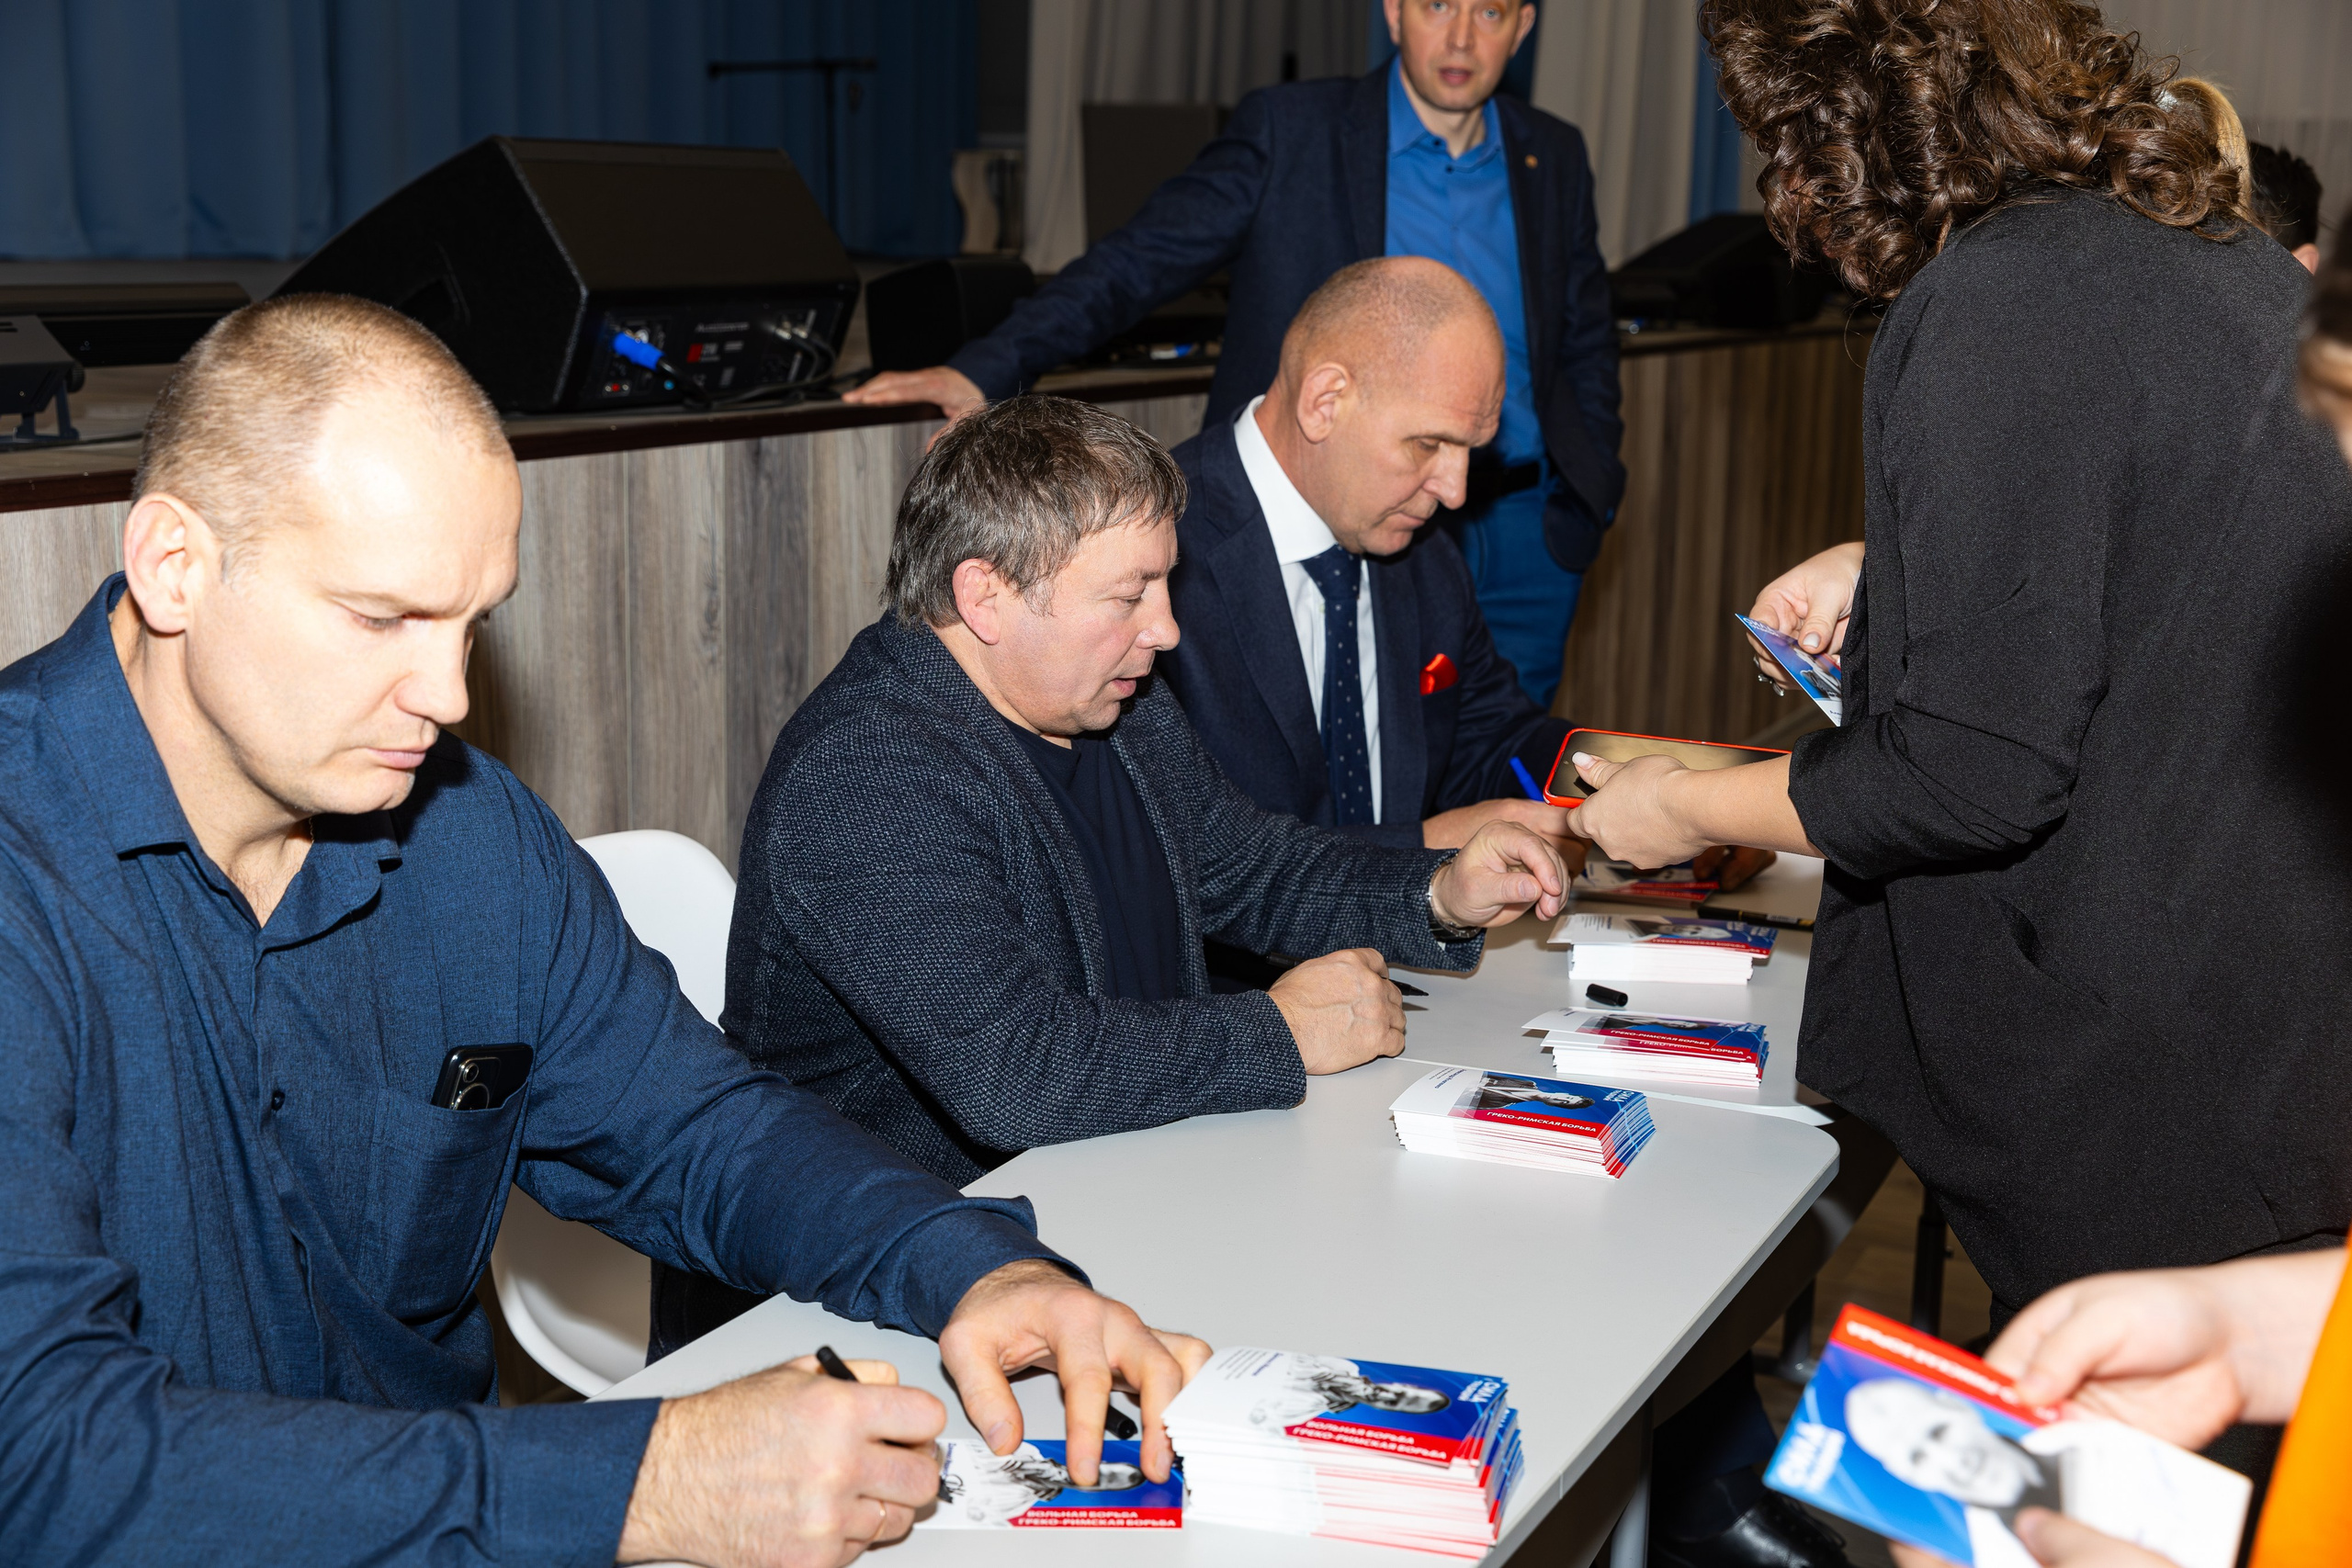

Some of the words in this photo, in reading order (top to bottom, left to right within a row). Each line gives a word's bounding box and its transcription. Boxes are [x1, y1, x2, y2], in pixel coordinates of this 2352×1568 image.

[1610, 1030, 1678, 1042] ГРЕКО-РИМСКАЯ
[1678, 1038, 1710, 1046] БОРЬБА
[1711, 1047, 1744, 1055] БОРЬБА
[1487, 1111, 1561, 1127] ГРЕКО-РИМСКАЯ
[1561, 1122, 1597, 1133] БОРЬБА
[1305, 1420, 1364, 1437] ВОЛЬНАЯ
[1365, 1429, 1415, 1445] БОРЬБА
[1293, 1427, 1396, 1451] ГРЕКО-РИМСКАЯ
[1396, 1444, 1447, 1460] БОРЬБА
[1026, 1509, 1088, 1518] ВОЛЬНАЯ
[1089, 1510, 1138, 1518] БОРЬБА
[1018, 1517, 1125, 1527] ГРЕКО-РИМСКАЯ
[1125, 1518, 1176, 1527] БОРЬБА
